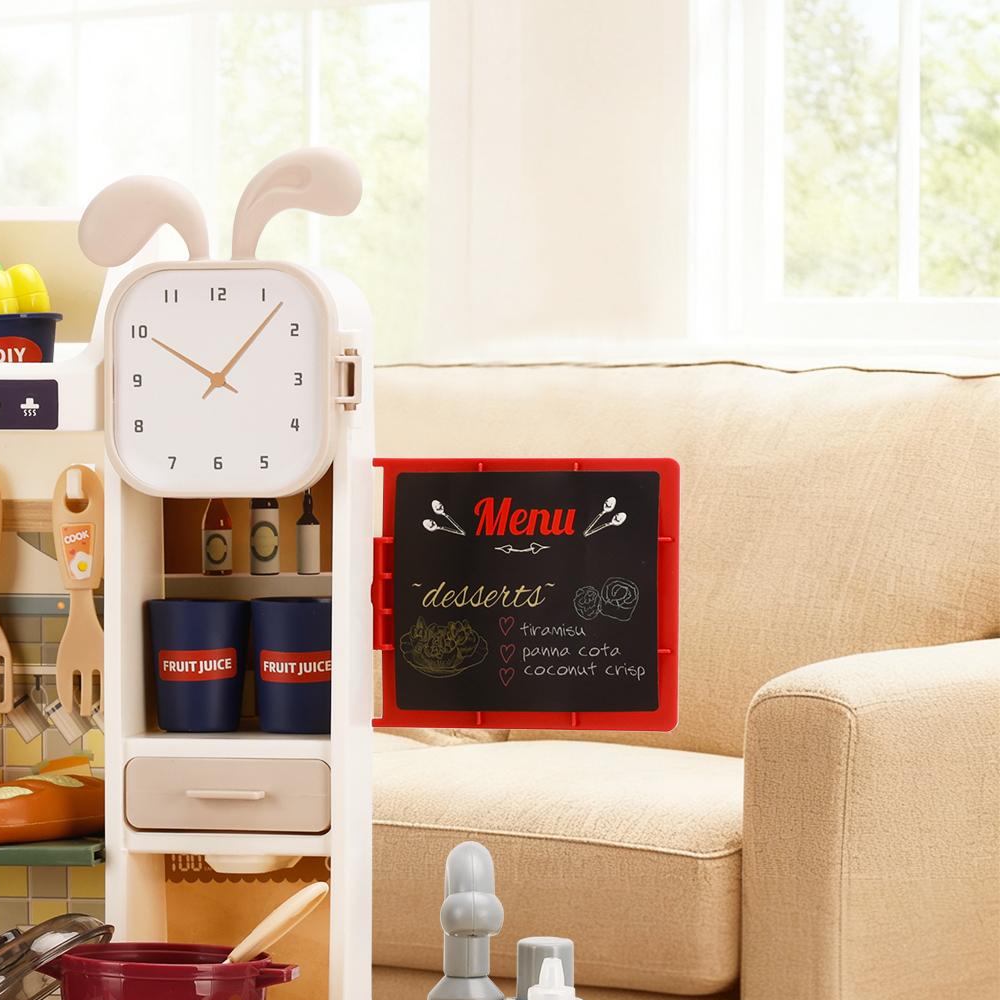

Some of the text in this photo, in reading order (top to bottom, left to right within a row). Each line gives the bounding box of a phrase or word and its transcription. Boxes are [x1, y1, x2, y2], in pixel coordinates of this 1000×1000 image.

[165, 289, 178, 303] 11
[210, 288, 227, 301] 12
[261, 288, 266, 302] 1
[131, 325, 148, 339] 10
[290, 323, 299, 337] 2
[133, 374, 142, 388] 9
[294, 372, 303, 386] 3
[134, 419, 144, 433] 8
[290, 418, 300, 431] 4
[167, 456, 177, 469] 7
[213, 456, 223, 470] 6
[259, 456, 269, 469] 5
[474, 497, 577, 536] Menu
[64, 531, 89, 544] COOK
[520, 622, 586, 636] tiramisu
[522, 643, 621, 662] panna cota
[163, 658, 232, 674] FRUIT JUICE
[263, 660, 332, 676] FRUIT JUICE
[524, 662, 646, 680] coconut crisp
